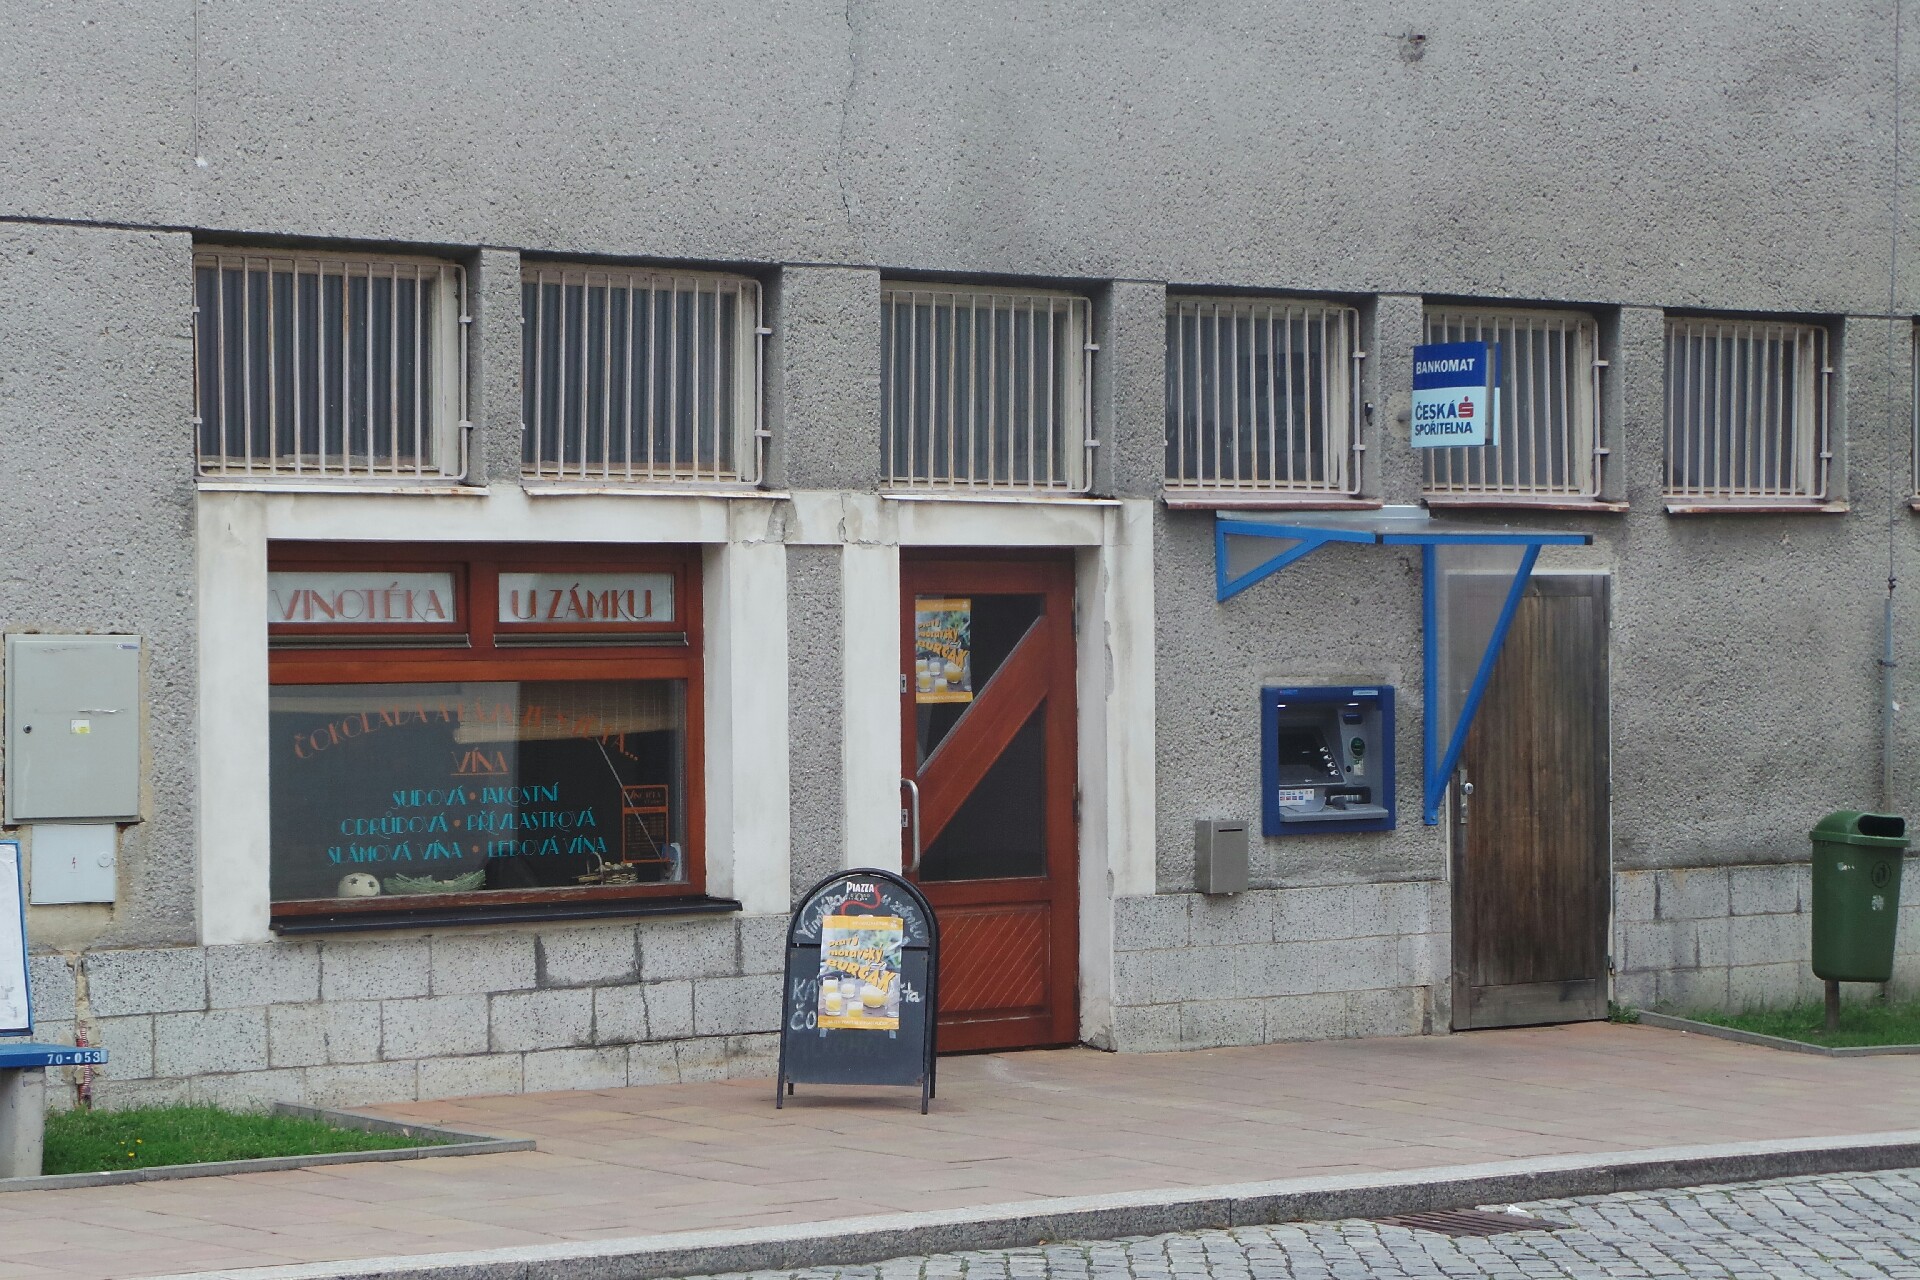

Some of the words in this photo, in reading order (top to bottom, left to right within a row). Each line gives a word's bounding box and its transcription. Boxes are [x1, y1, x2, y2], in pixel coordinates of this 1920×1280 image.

[1415, 358, 1475, 375] BANKOMAT
[1414, 400, 1458, 421] ČESKÁ
[1414, 420, 1473, 437] SPOŘITELNA
[271, 581, 446, 622] VINOTÉKA
[511, 589, 537, 619] U
[547, 582, 652, 622] ZÁMKU
[450, 746, 511, 775] VÍNA
[391, 785, 466, 810] SUDOVÁ
[480, 782, 559, 807] JAKOSTNÍ
[341, 811, 449, 839] ODRŮDOVÁ
[467, 806, 596, 835] PŘÍVLASTKOVÁ
[327, 841, 412, 867] SLÁMOVÁ
[416, 839, 463, 860] VÍNA
[487, 835, 560, 858] LEDOVÁ
[563, 834, 607, 857] VÍNA
[792, 977, 818, 1003] KA
[825, 958, 897, 994] BURČÁK
[790, 1002, 818, 1030] ČO
[48, 1051, 101, 1065] 70-053
